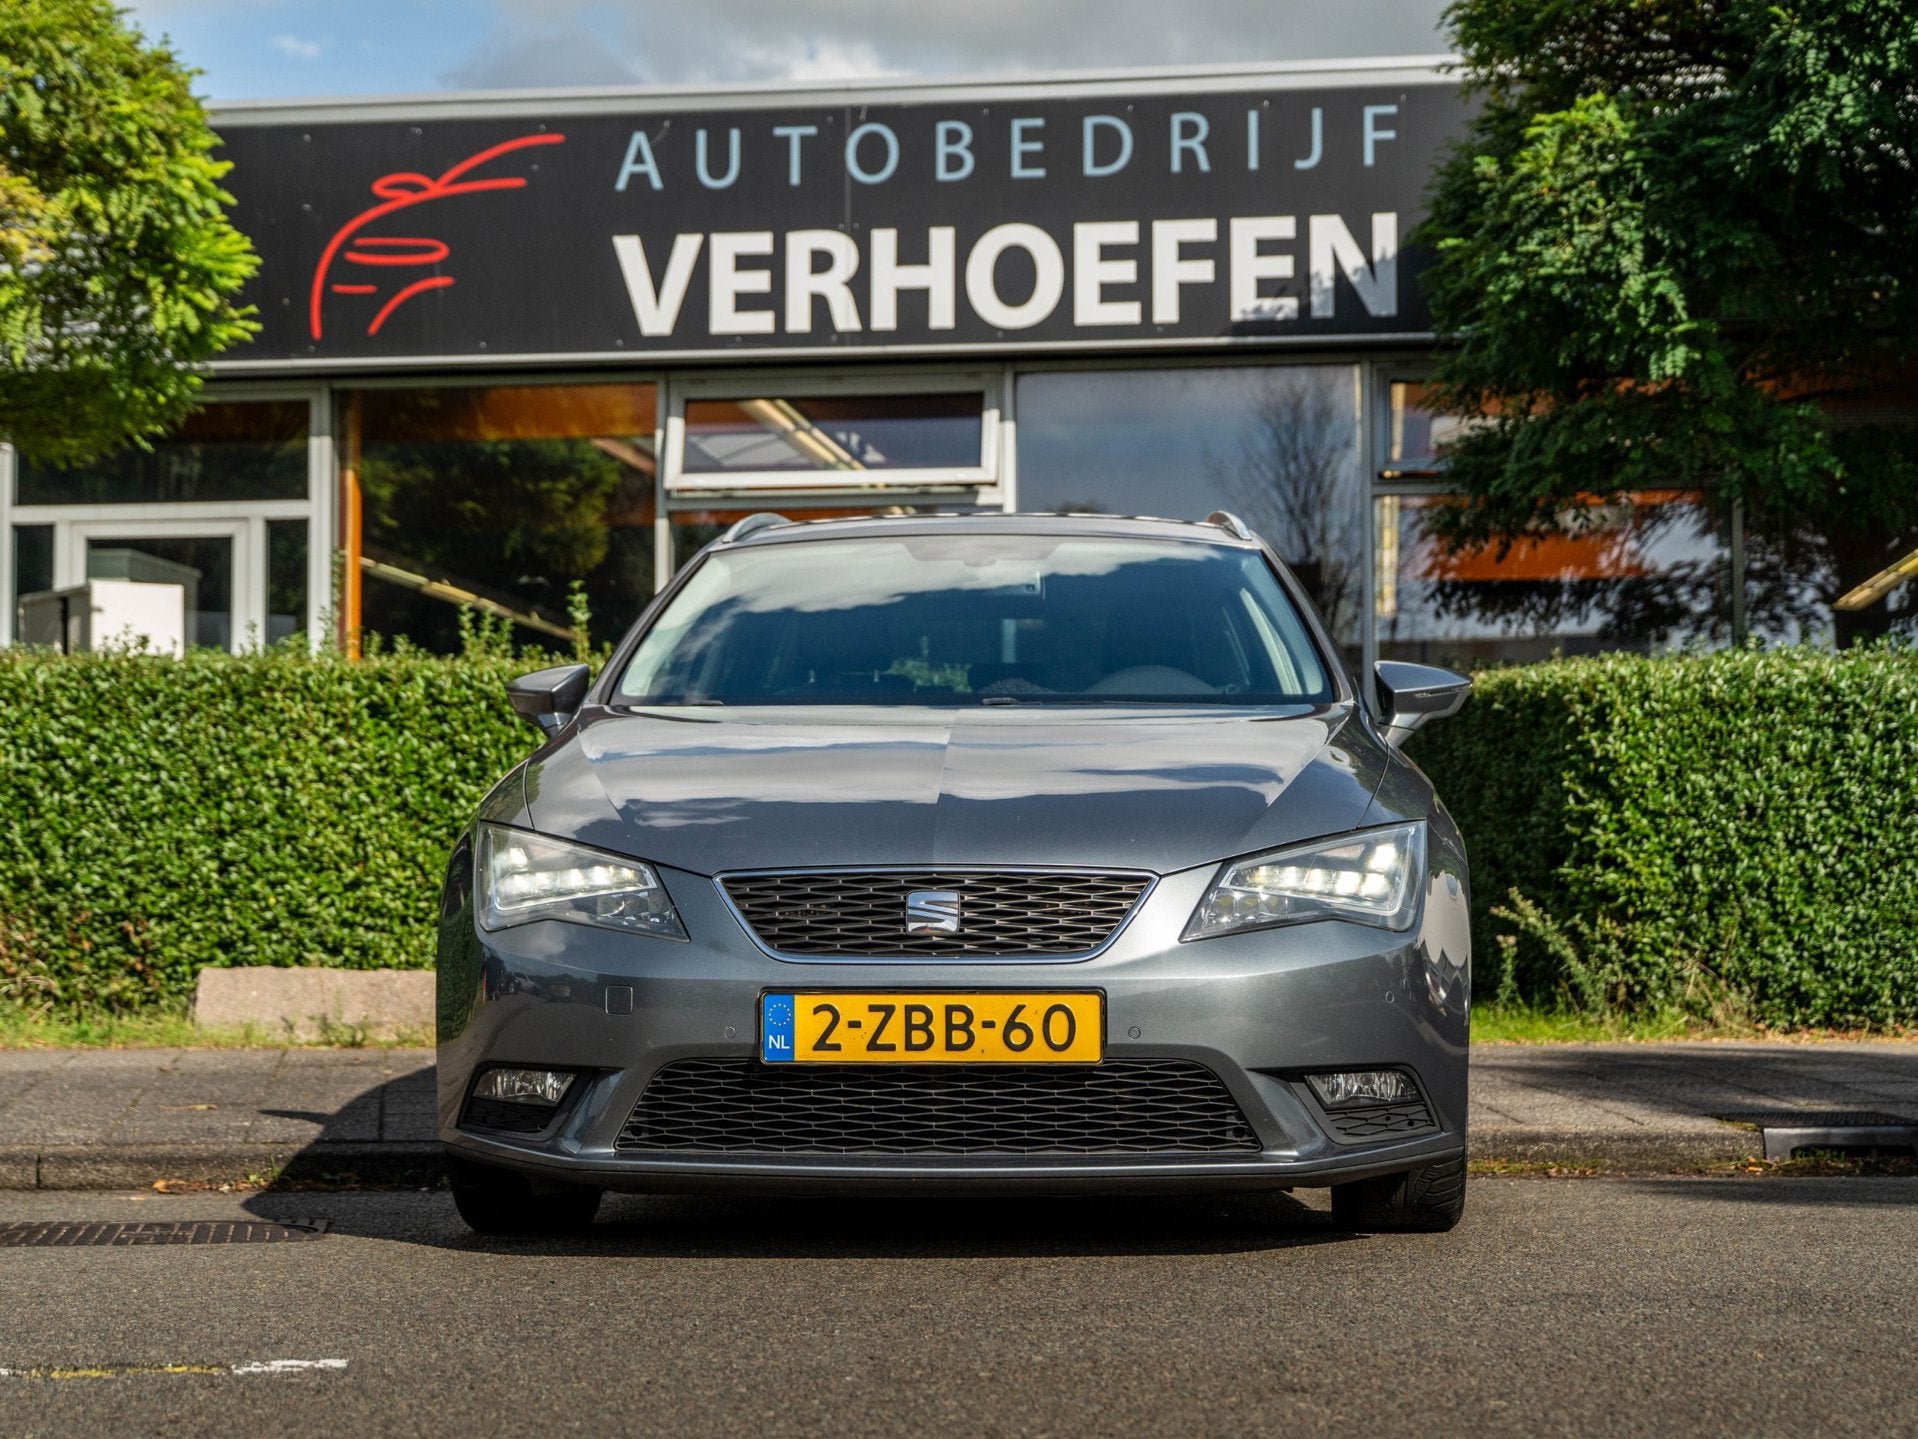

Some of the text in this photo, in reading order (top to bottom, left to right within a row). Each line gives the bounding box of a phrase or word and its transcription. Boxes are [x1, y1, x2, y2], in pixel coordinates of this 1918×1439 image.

[614, 103, 1399, 192] AUTOBEDRIJF
[612, 211, 1399, 337] VERHOEFEN
[768, 1034, 790, 1049] NL
[812, 1003, 1077, 1052] 2-ZBB-60
